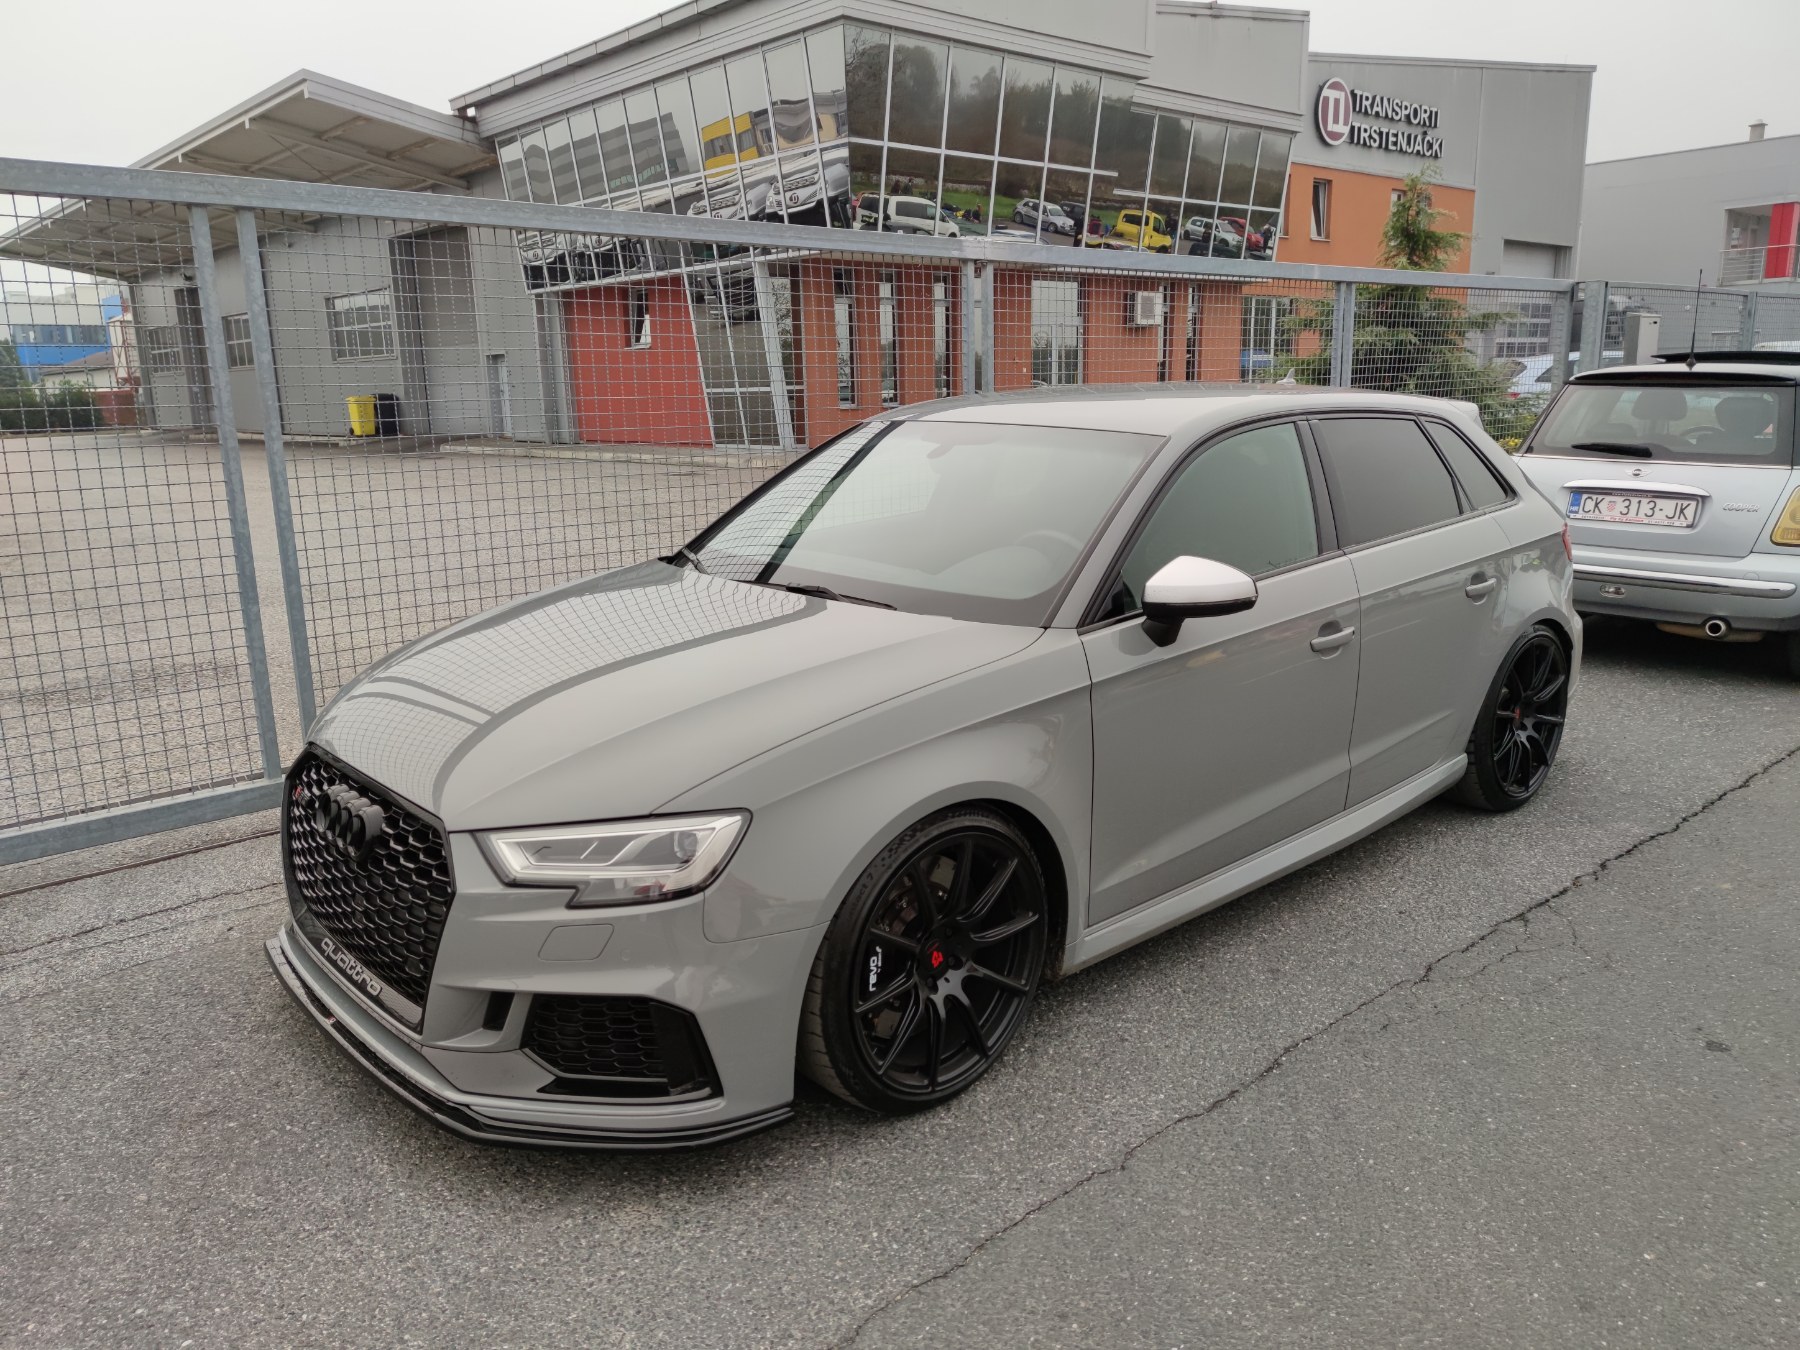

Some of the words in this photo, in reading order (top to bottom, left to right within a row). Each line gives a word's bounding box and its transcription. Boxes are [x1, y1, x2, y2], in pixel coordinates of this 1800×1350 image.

[1353, 89, 1441, 128] TRANSPORTI
[1351, 121, 1445, 157] TRSTENJAČKI
[1582, 496, 1605, 514] CK
[1620, 498, 1692, 520] 313-JK
[1722, 502, 1760, 512] COOPER
[321, 938, 382, 996] quattro
[869, 956, 878, 992] revo
